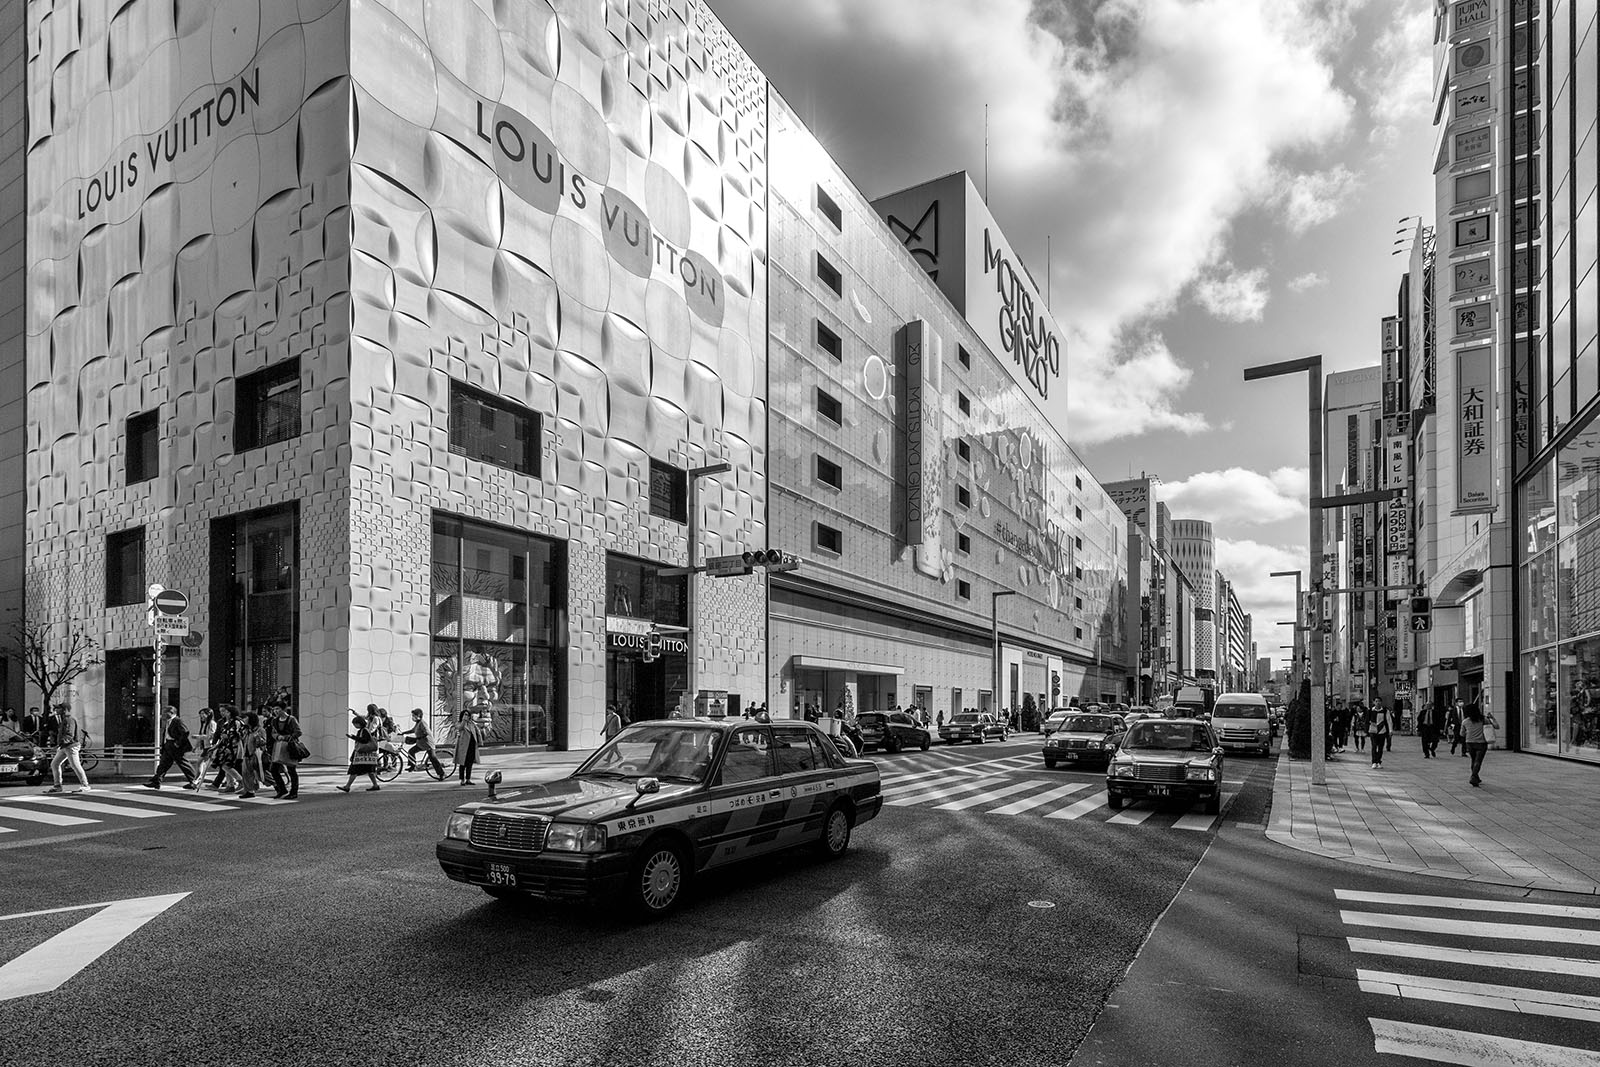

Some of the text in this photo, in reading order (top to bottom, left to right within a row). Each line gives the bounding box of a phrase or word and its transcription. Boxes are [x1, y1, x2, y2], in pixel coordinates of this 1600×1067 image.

[1459, 10, 1486, 25] HALL
[78, 67, 260, 220] LOUIS VUITTON
[477, 100, 716, 306] LOUIS VUITTON
[984, 227, 1060, 378] MATSUYA
[999, 304, 1048, 401] GINZA
[1463, 387, 1485, 457] 大和証券
[1393, 441, 1402, 484] 南風ビル
[1463, 496, 1489, 504] Securities
[613, 634, 645, 649] LOUIS
[617, 814, 655, 832] 東京無線
[490, 871, 517, 886] 99-79
